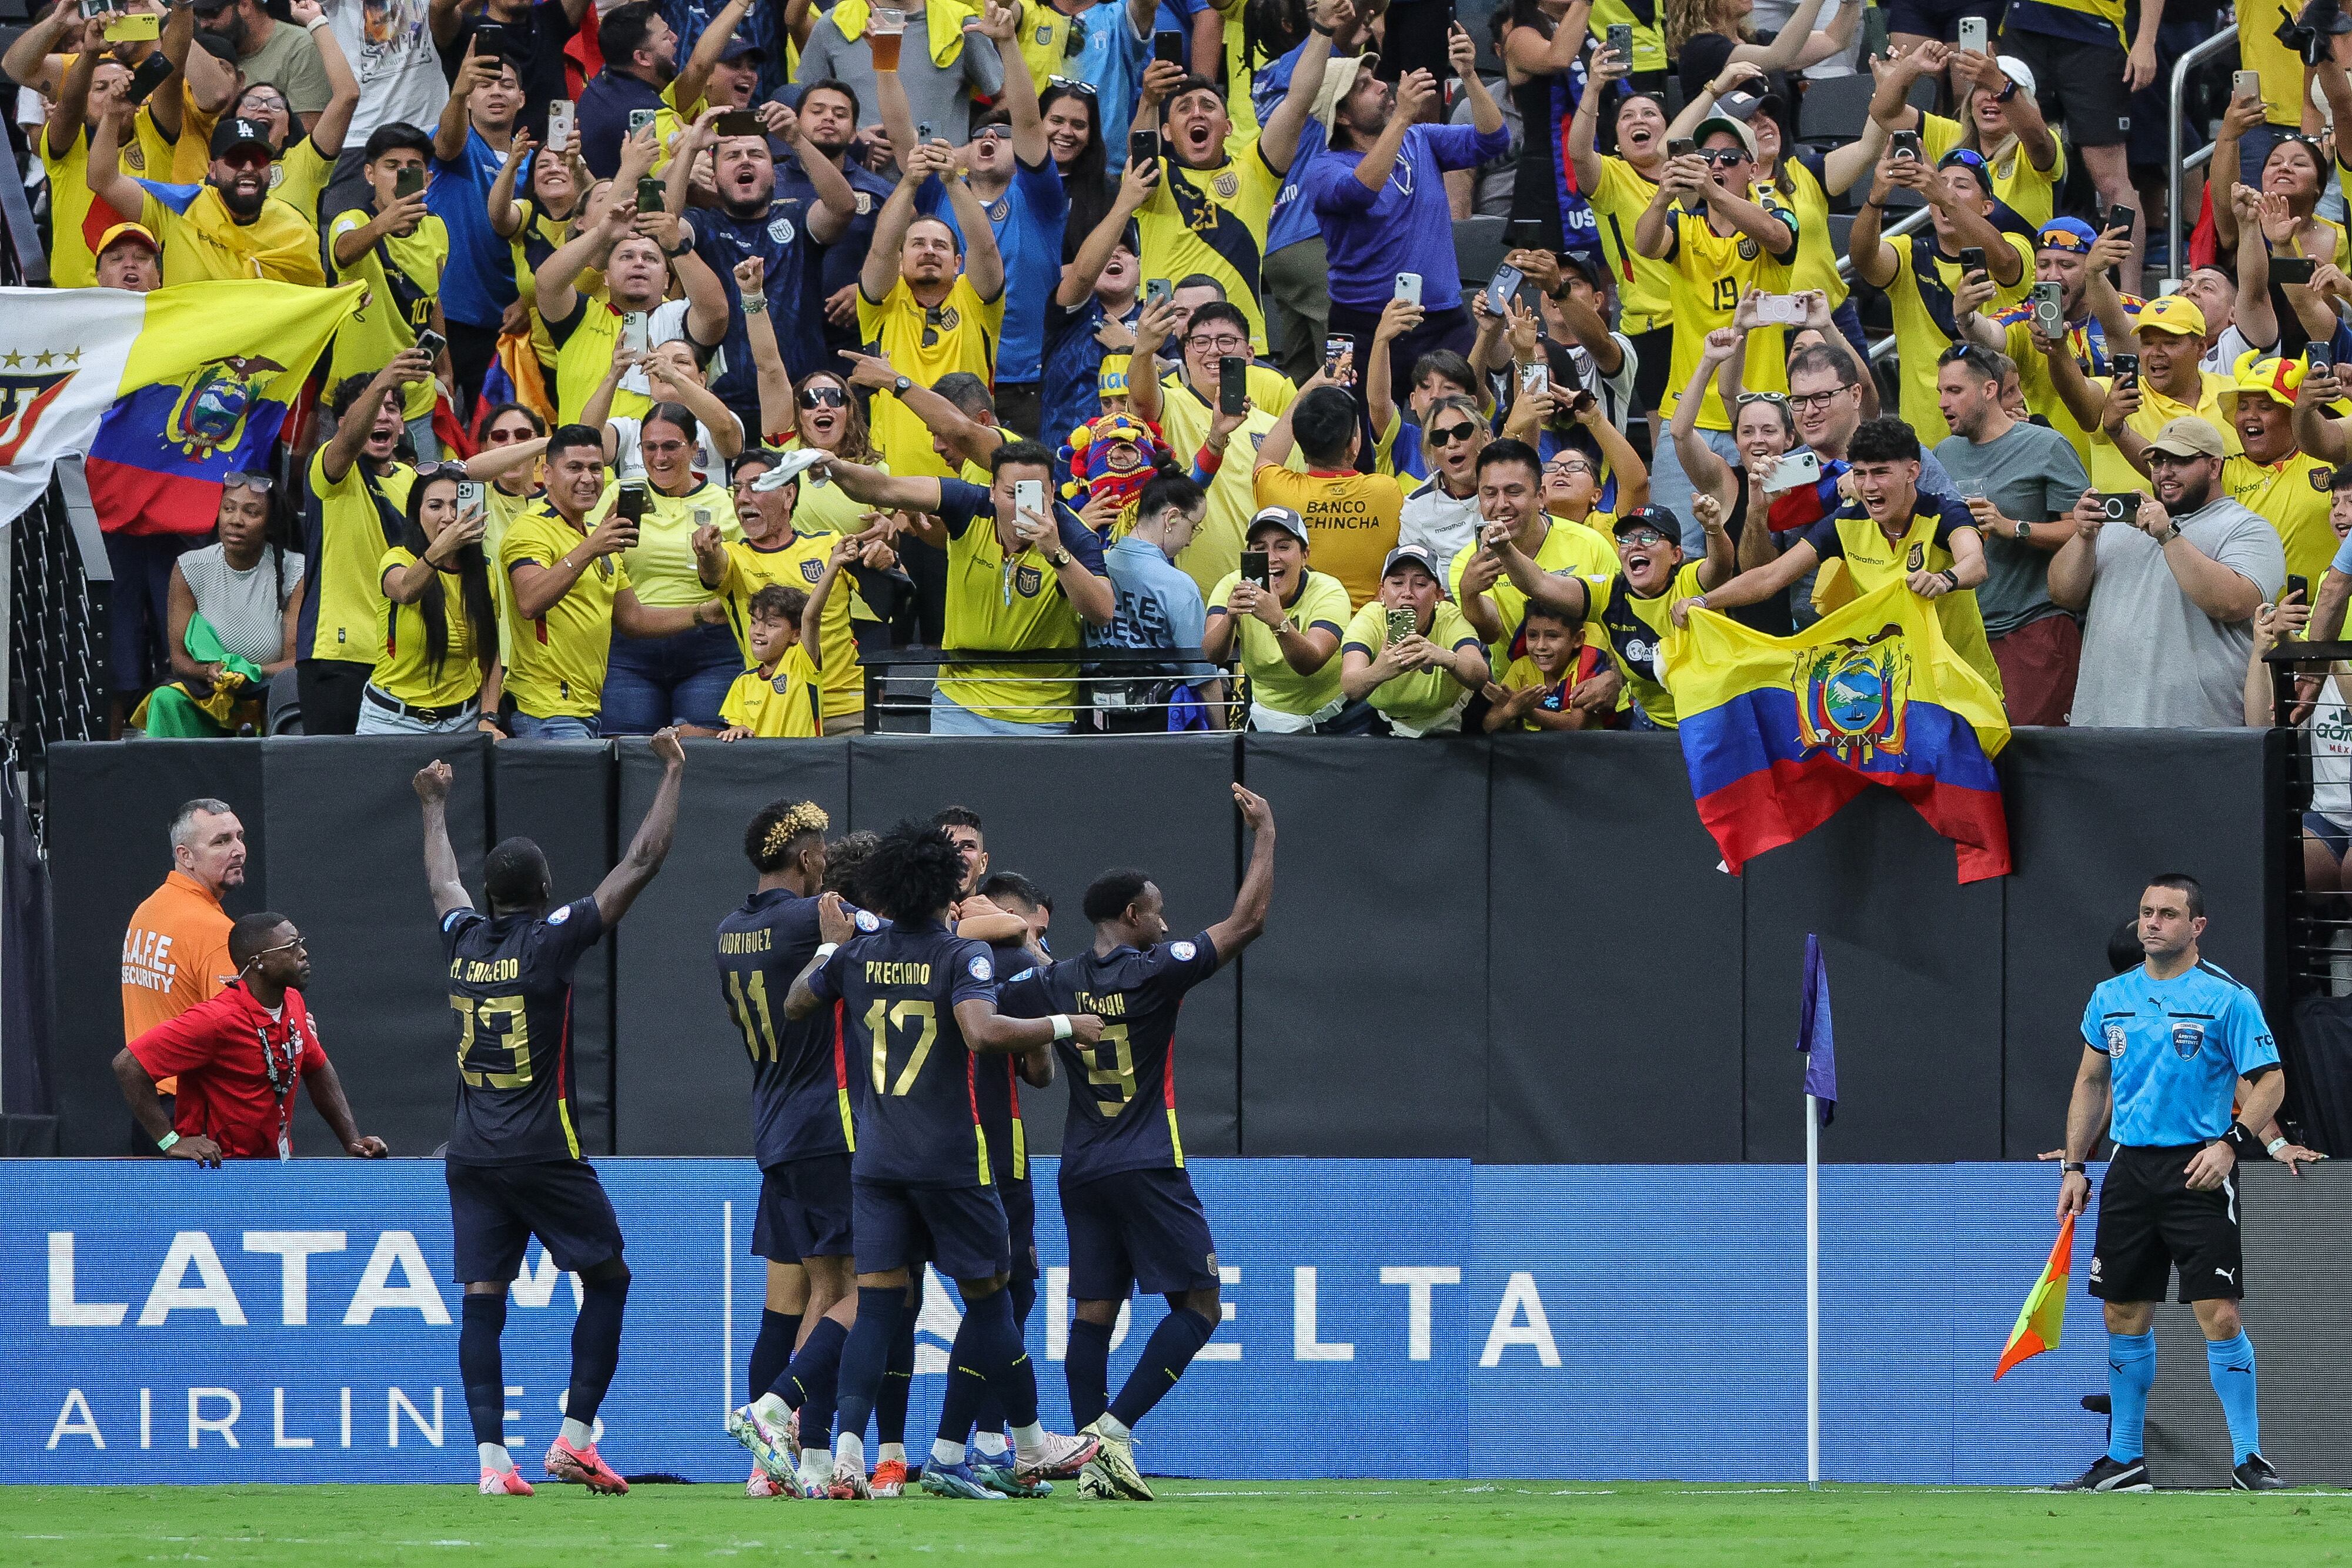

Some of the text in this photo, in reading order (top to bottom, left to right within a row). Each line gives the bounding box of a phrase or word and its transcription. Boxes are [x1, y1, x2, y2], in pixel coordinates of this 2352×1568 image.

[236, 119, 254, 138] LA
[1191, 199, 1219, 231] 23
[1712, 275, 1739, 310] 19
[411, 297, 431, 325] 10
[1306, 500, 1366, 514] BANCO
[1304, 516, 1380, 529] CHINCHA
[1435, 521, 1466, 533] marathon
[1847, 551, 1885, 565] marathon
[121, 965, 174, 994] SECURITY
[866, 960, 931, 985] PRECIADO
[730, 970, 777, 1063] 11
[449, 994, 533, 1089] 23
[863, 999, 937, 1096] 17
[1081, 1024, 1137, 1117] 9
